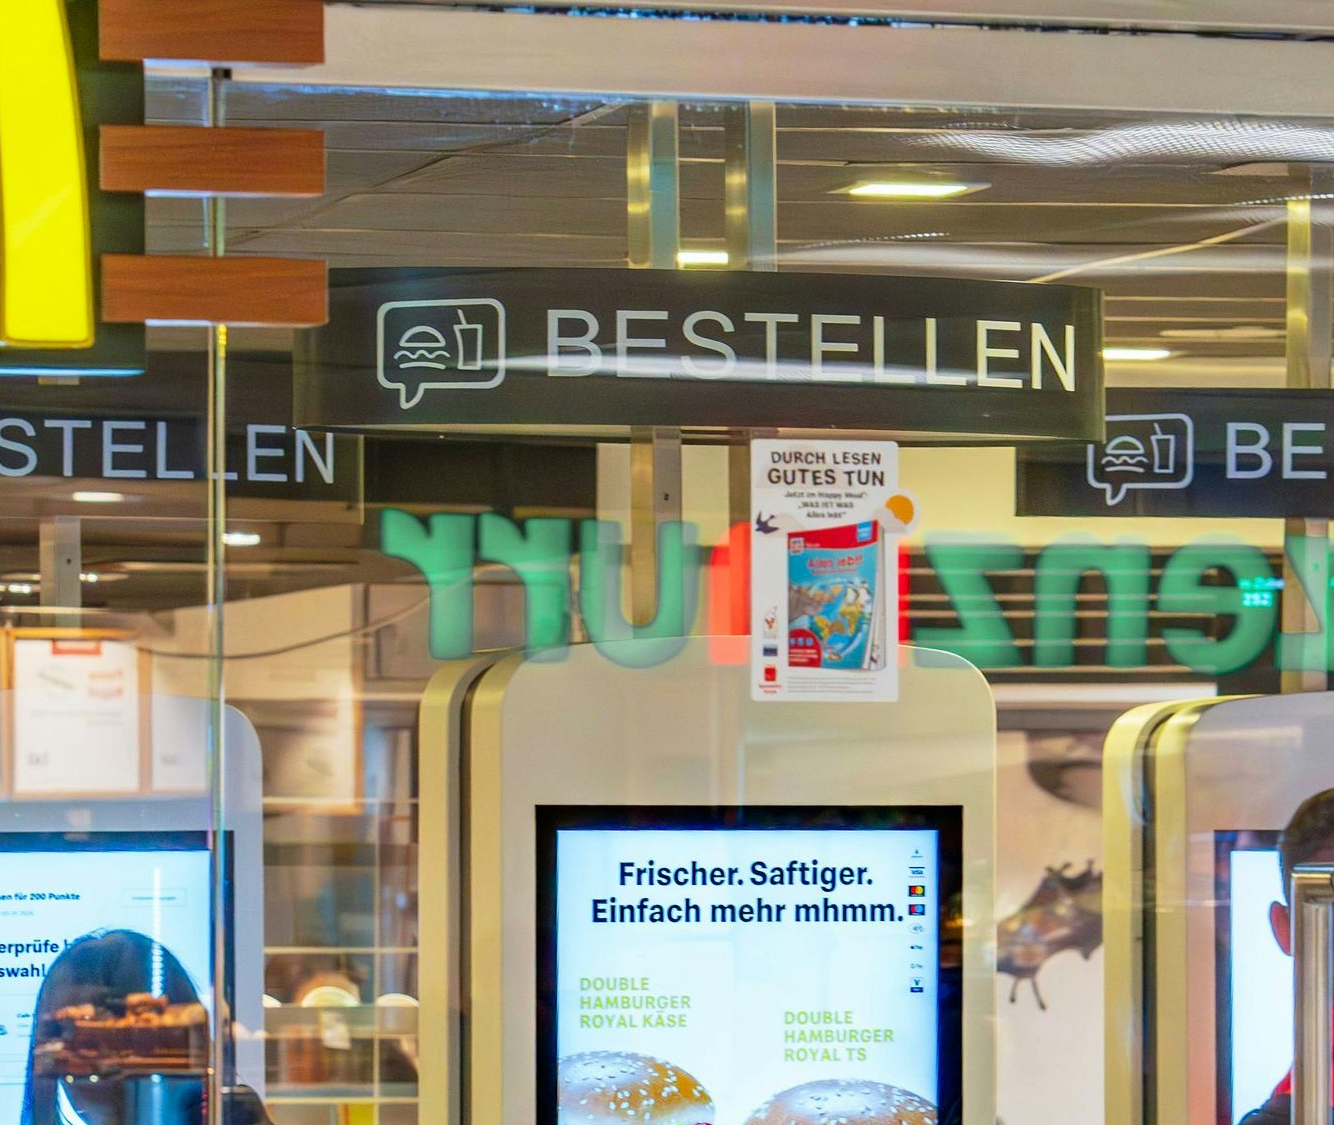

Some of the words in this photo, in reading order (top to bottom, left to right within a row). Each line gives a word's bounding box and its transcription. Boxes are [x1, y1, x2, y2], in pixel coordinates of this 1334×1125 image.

[547, 309, 1076, 392] BESTELLEN
[771, 451, 826, 465] DURCH
[833, 451, 882, 465] LESEN
[767, 468, 836, 486] GUTES
[843, 469, 885, 487] TUN
[619, 860, 744, 886] Frischer.
[750, 859, 873, 892] Saftiger.
[14, 892, 28, 901] für
[48, 893, 81, 901] Punkte
[591, 898, 701, 923] Einfach
[711, 898, 786, 923] mehr
[795, 898, 904, 922] mhmm.
[579, 977, 650, 991] DOUBLE
[579, 996, 691, 1010] HAMBURGER
[579, 1014, 638, 1028] ROYAL
[643, 1010, 688, 1028] KÄSE
[784, 1011, 854, 1025] DOUBLE
[784, 1029, 895, 1043] HAMBURGER
[784, 1047, 841, 1061] ROYAL
[847, 1047, 867, 1061] TS
